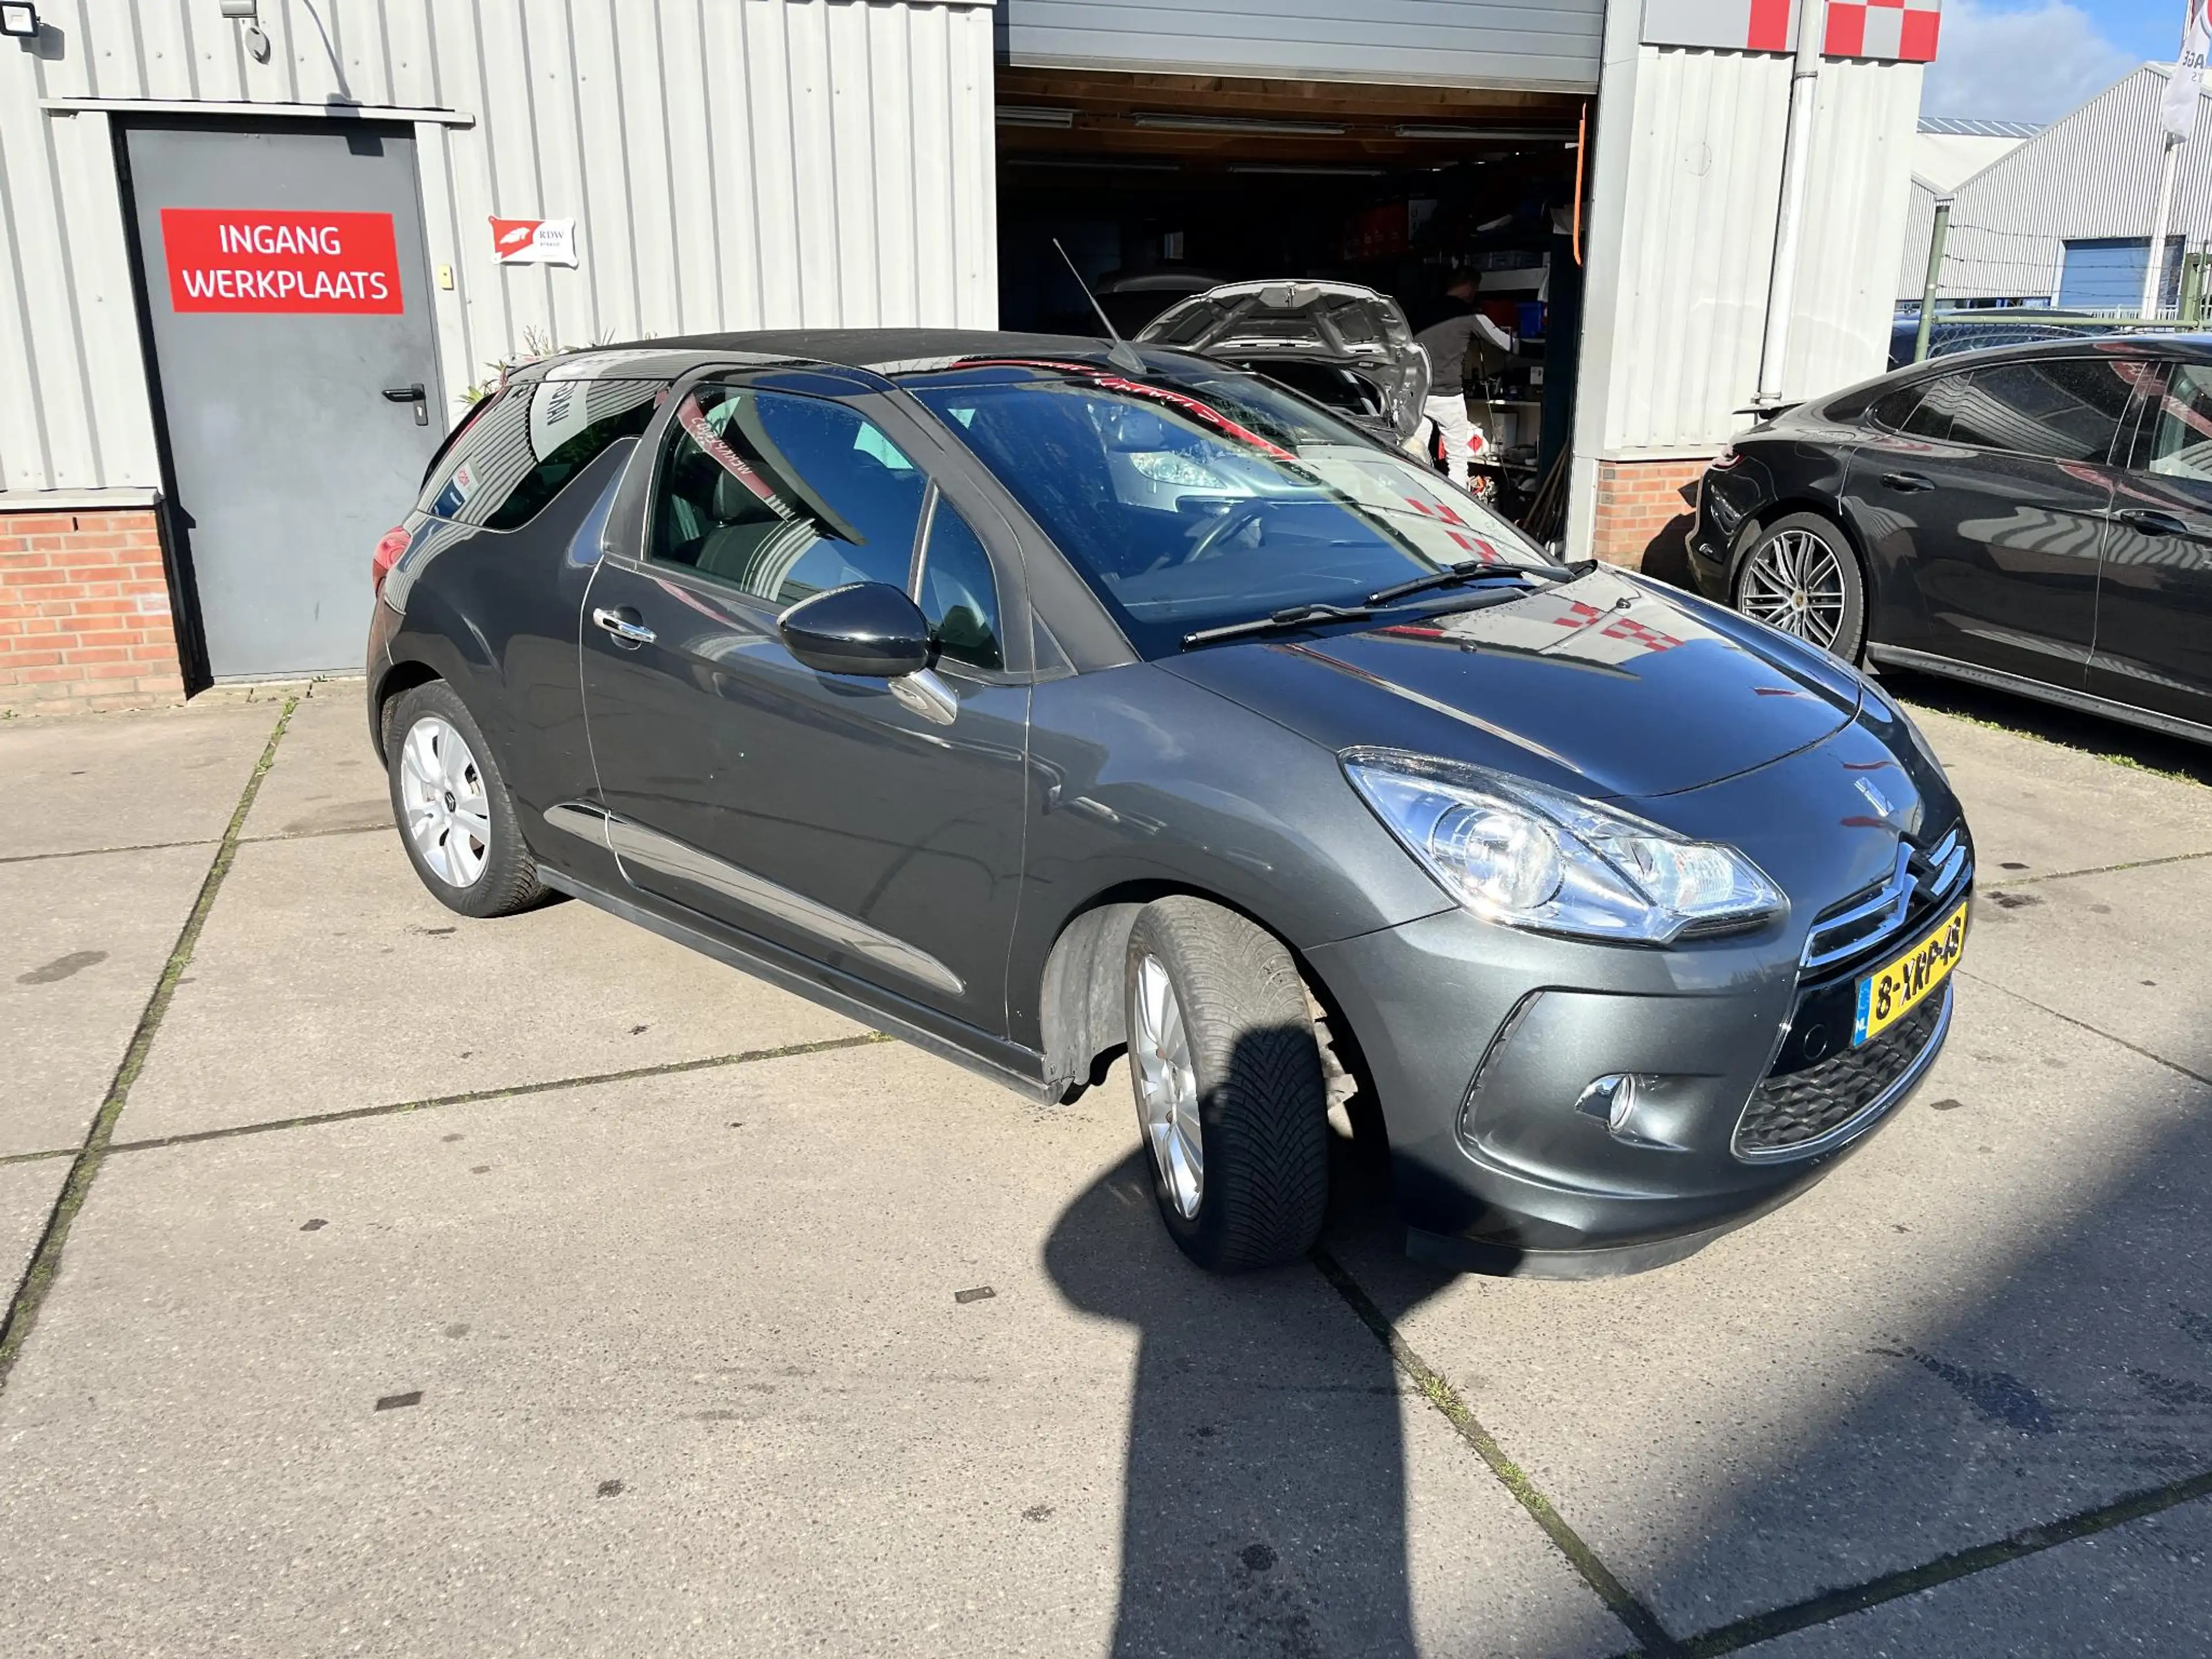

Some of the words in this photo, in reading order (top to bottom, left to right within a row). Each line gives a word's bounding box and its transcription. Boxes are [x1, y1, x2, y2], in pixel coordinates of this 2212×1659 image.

[219, 224, 341, 255] INGANG
[182, 270, 389, 299] WERKPLAATS
[1855, 1017, 1866, 1032] NL
